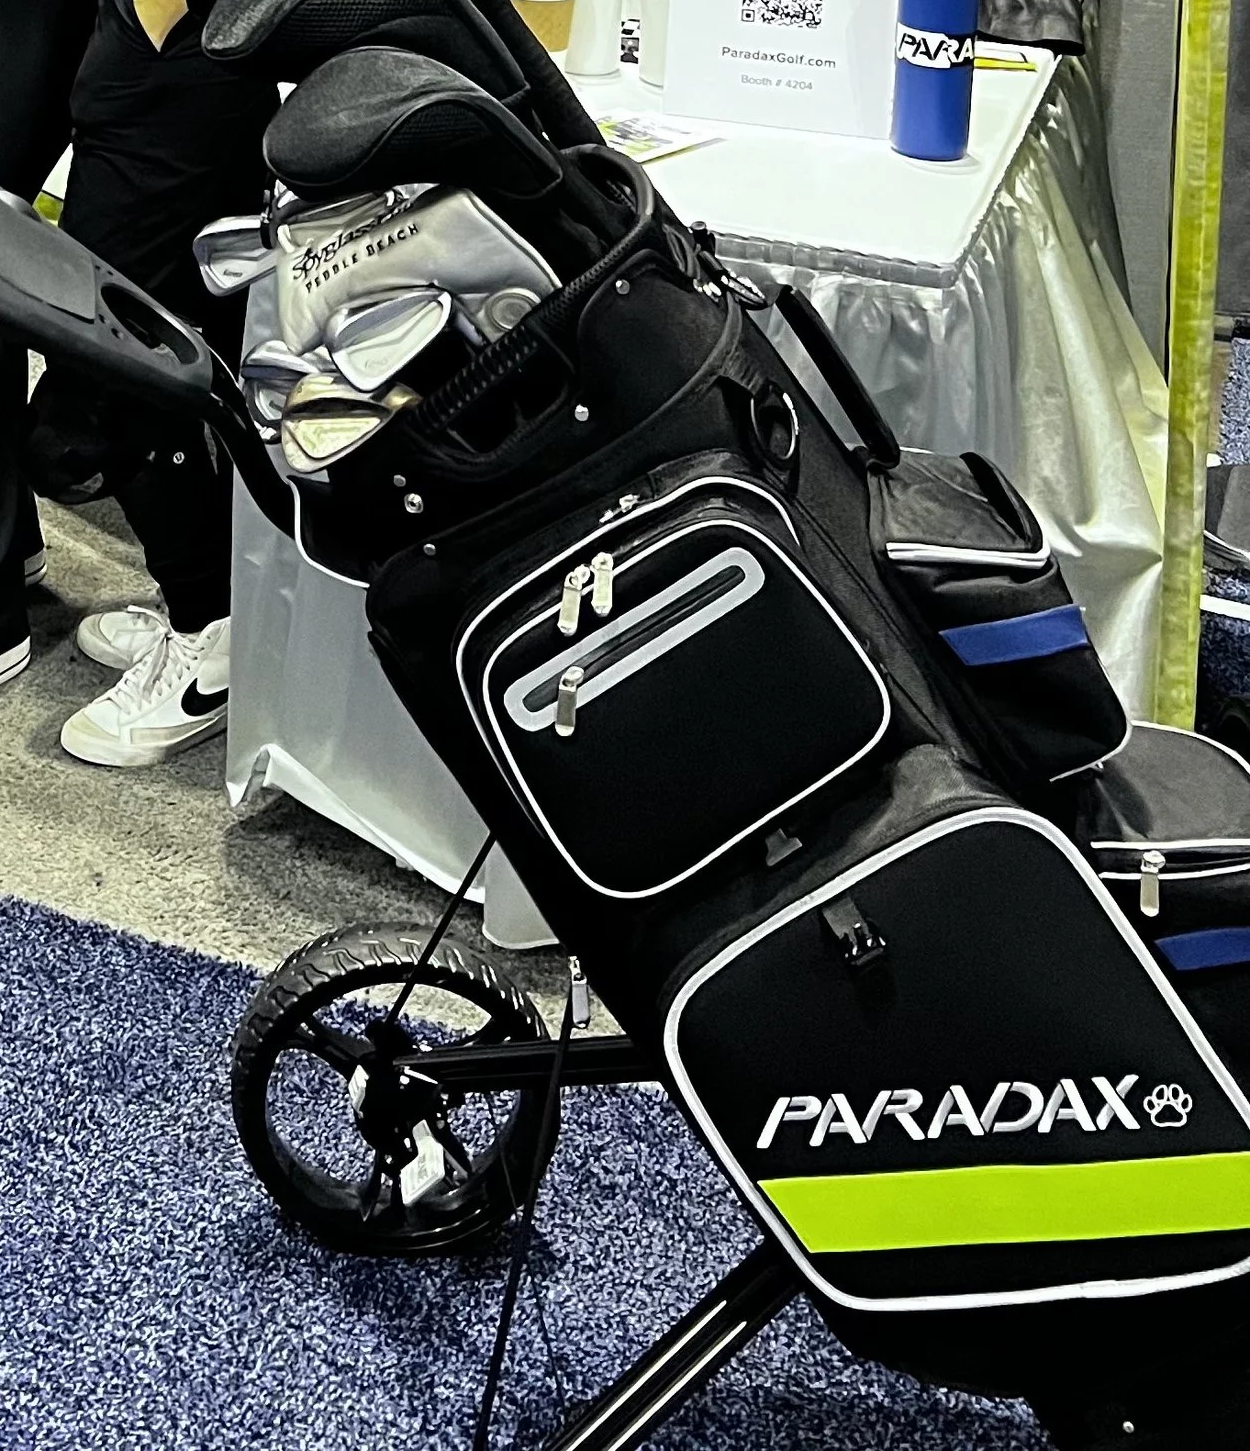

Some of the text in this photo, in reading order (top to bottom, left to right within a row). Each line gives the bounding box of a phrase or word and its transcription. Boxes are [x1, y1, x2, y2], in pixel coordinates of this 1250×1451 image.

[721, 46, 837, 68] ParadaxGolf.com
[741, 74, 814, 90] Booth # 4204
[365, 223, 419, 257] BEACH
[756, 1074, 1140, 1149] PARADAX
